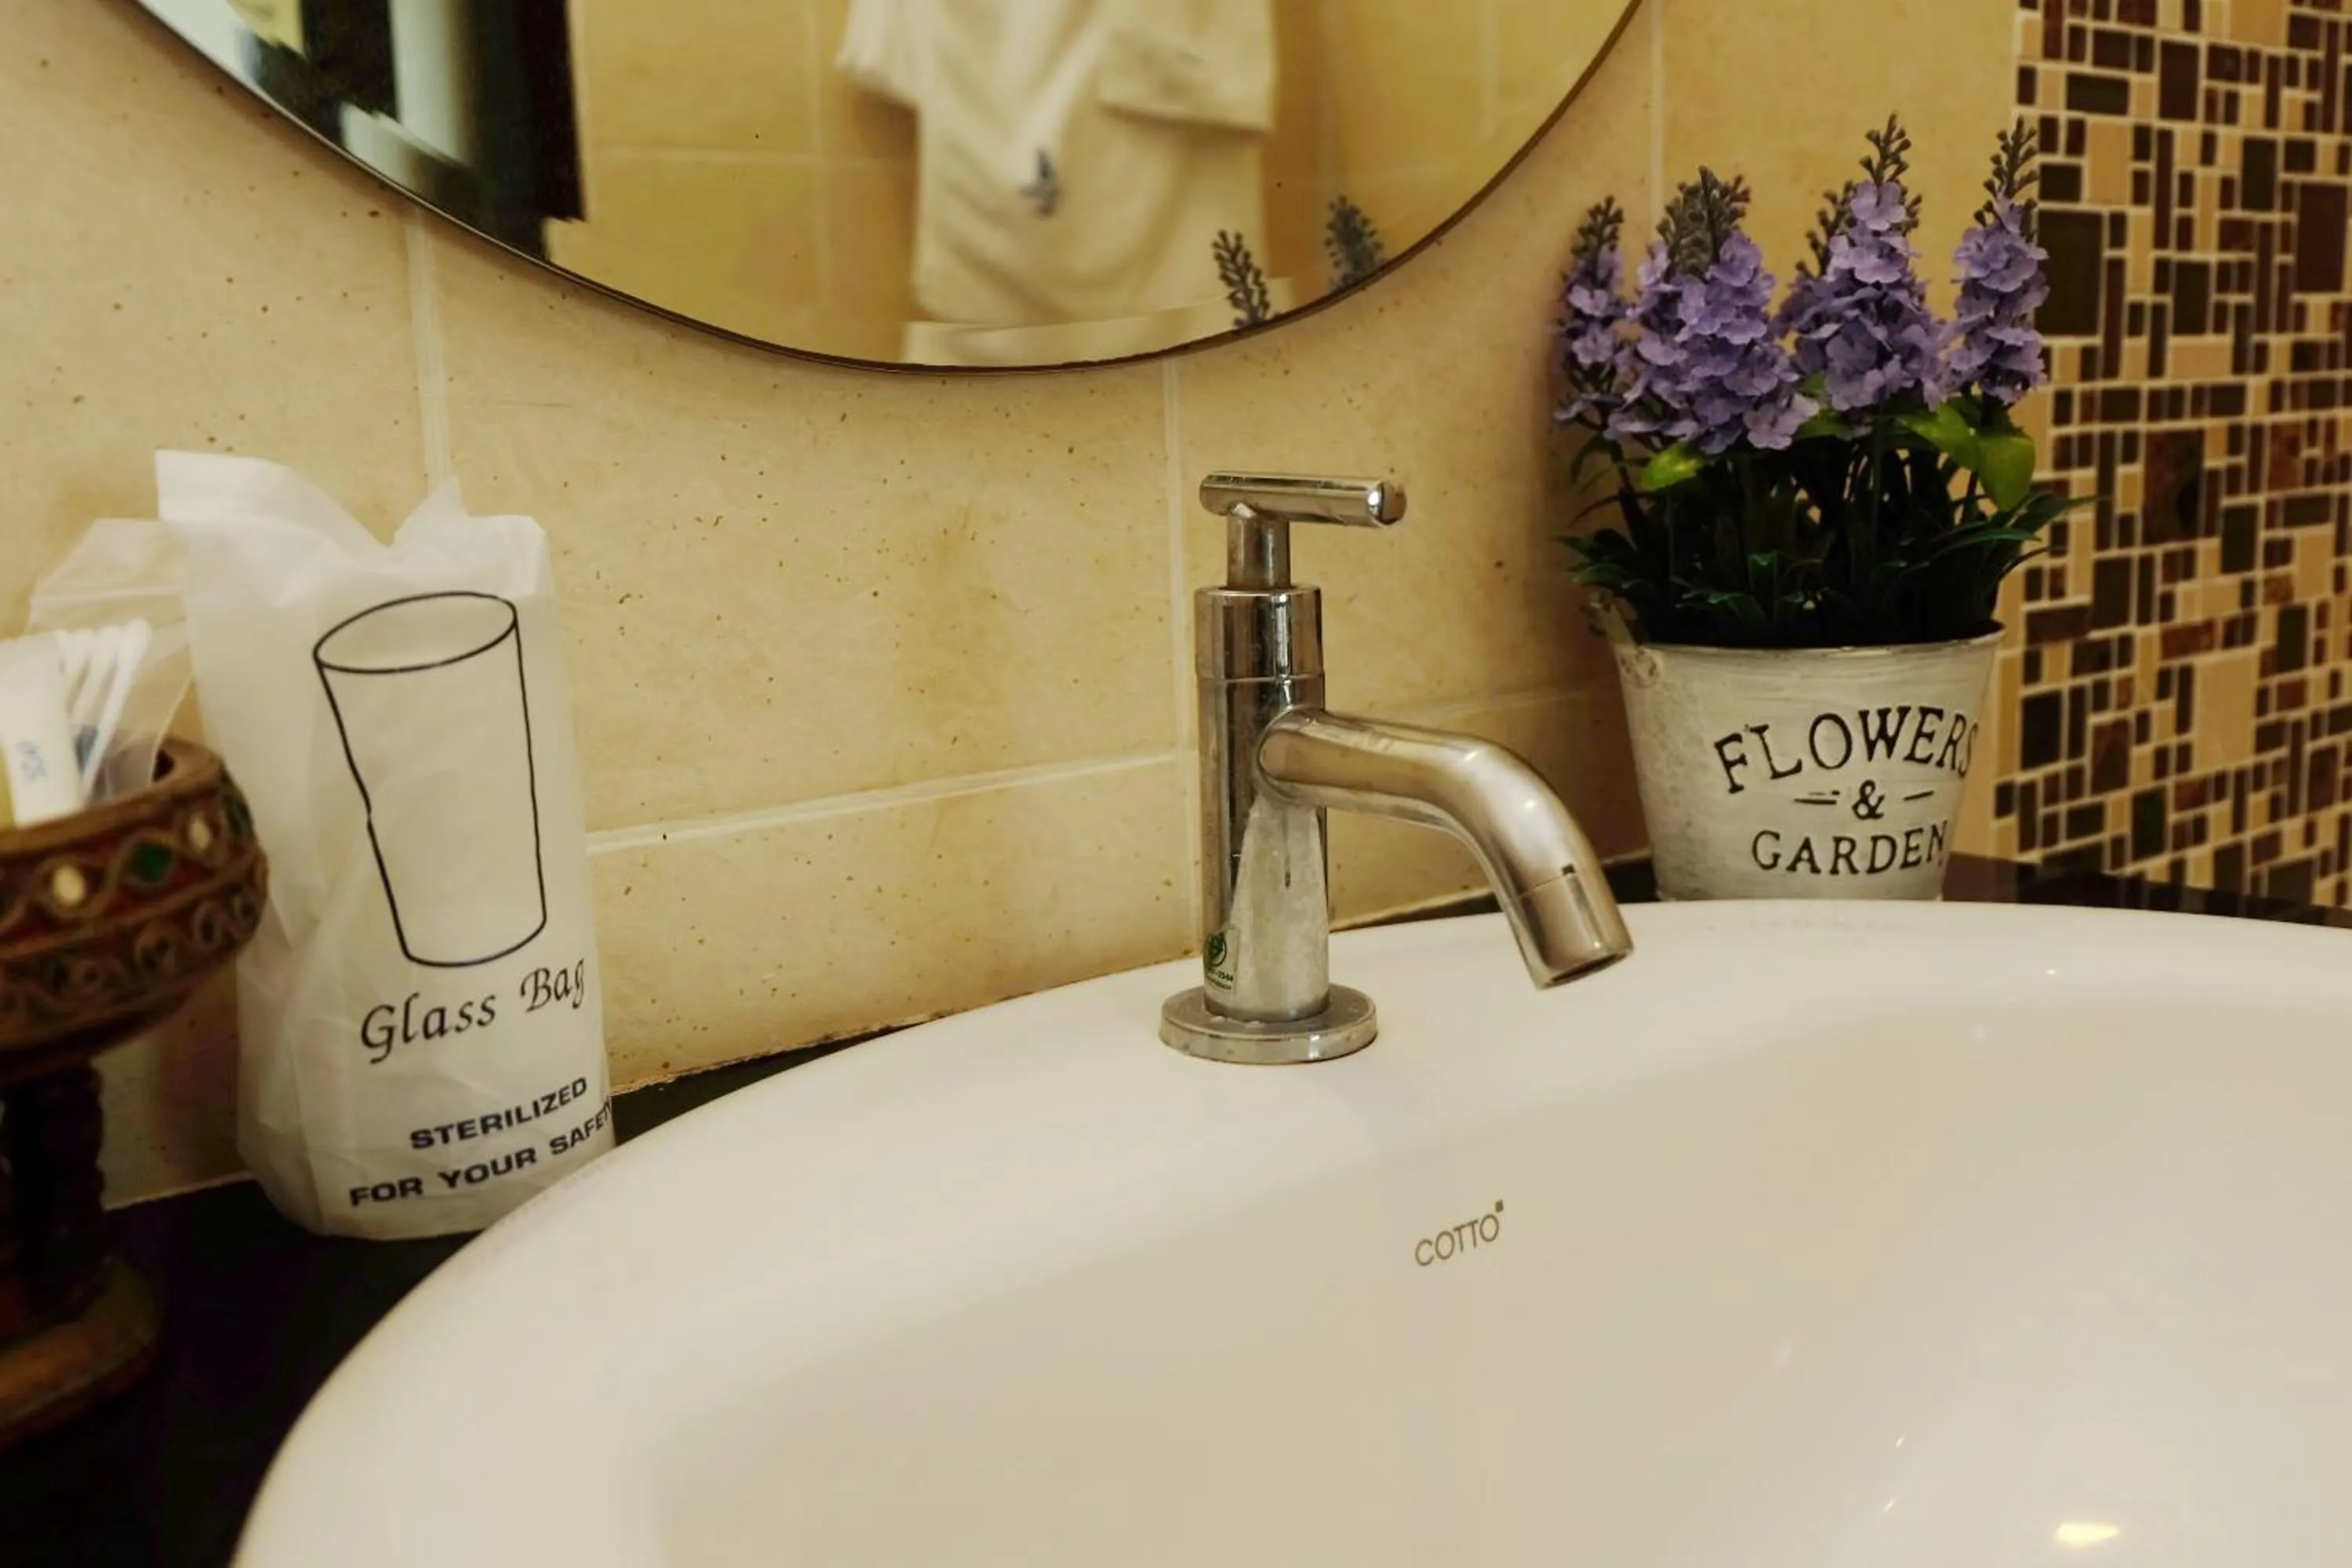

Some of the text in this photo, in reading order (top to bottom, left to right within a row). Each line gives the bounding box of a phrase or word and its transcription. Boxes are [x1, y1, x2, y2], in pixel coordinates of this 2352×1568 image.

[1714, 706, 1979, 793] FLOWERS
[1852, 779, 1886, 820] &
[1751, 819, 1948, 876] GARDEN
[361, 958, 585, 1065] Glass Bag
[409, 1076, 587, 1149] STERILIZED
[349, 1177, 423, 1207] FOR
[438, 1147, 537, 1189] YOUR
[1414, 1213, 1500, 1267] COTTO
